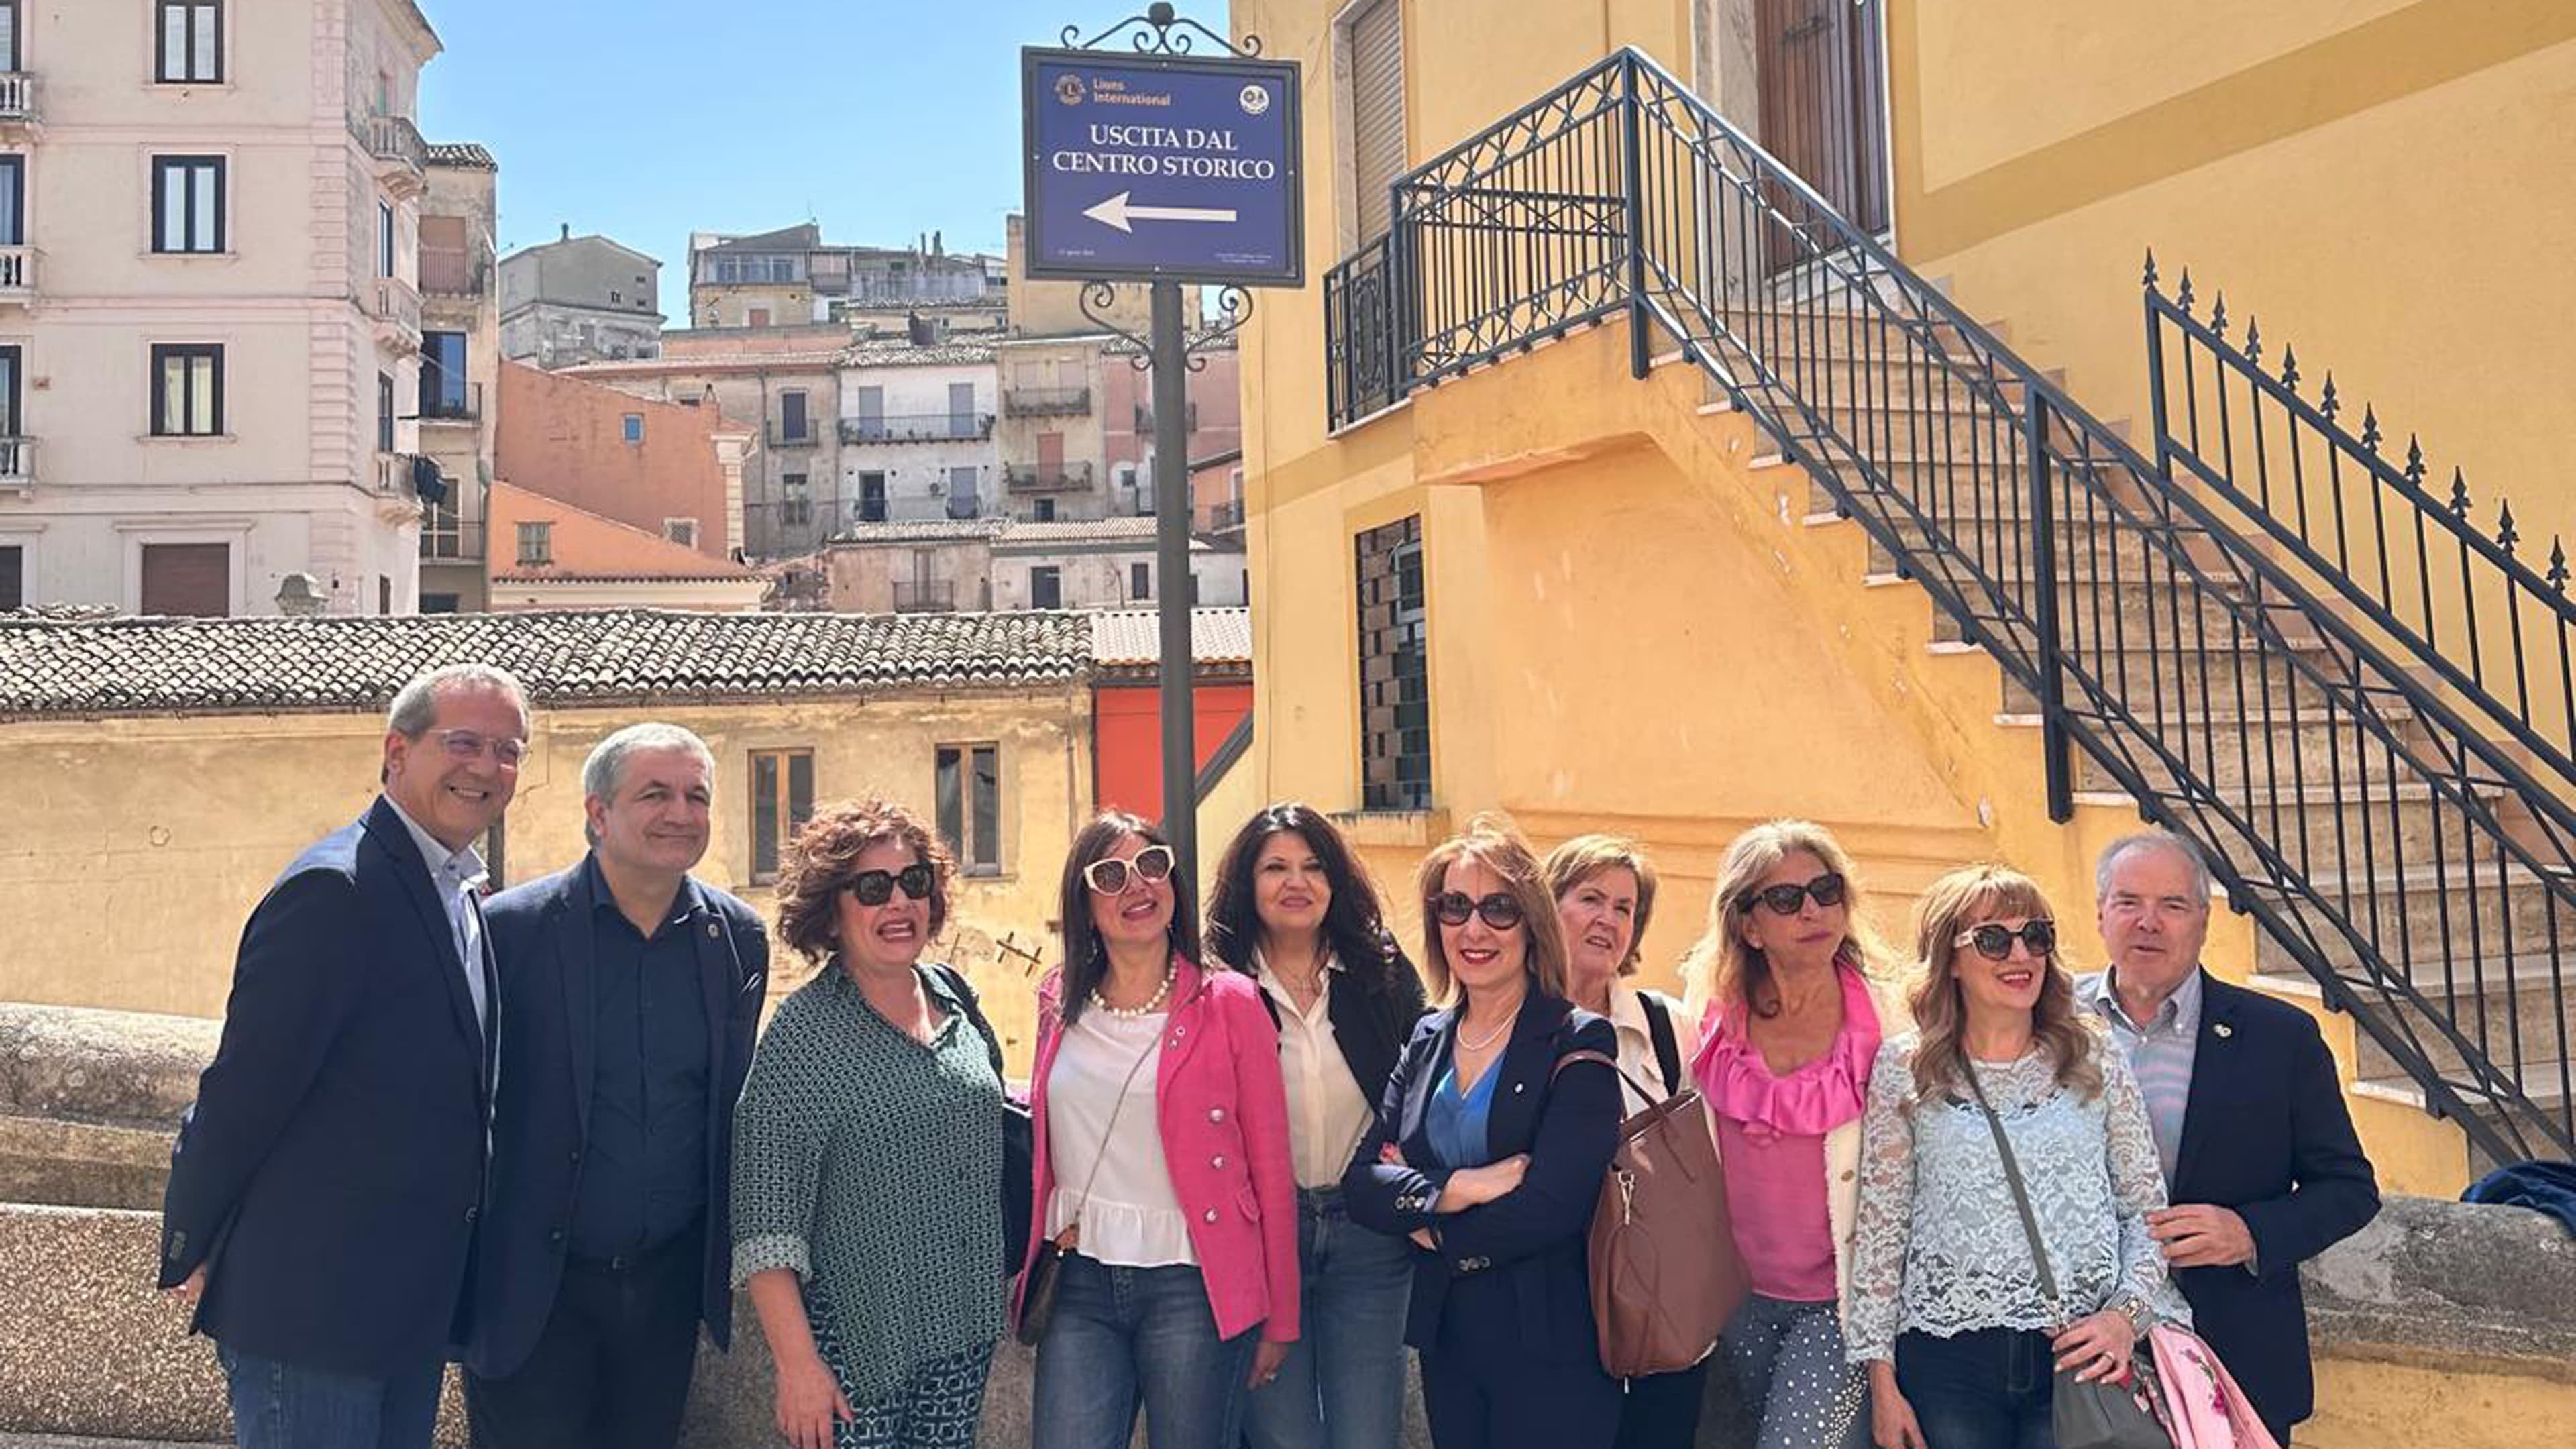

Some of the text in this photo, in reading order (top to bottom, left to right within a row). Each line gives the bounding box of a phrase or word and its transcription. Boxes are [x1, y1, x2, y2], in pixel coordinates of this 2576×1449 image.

[1093, 91, 1171, 106] International
[1090, 124, 1238, 151] USCITA DAL
[1053, 151, 1275, 180] CENTRO STORICO
